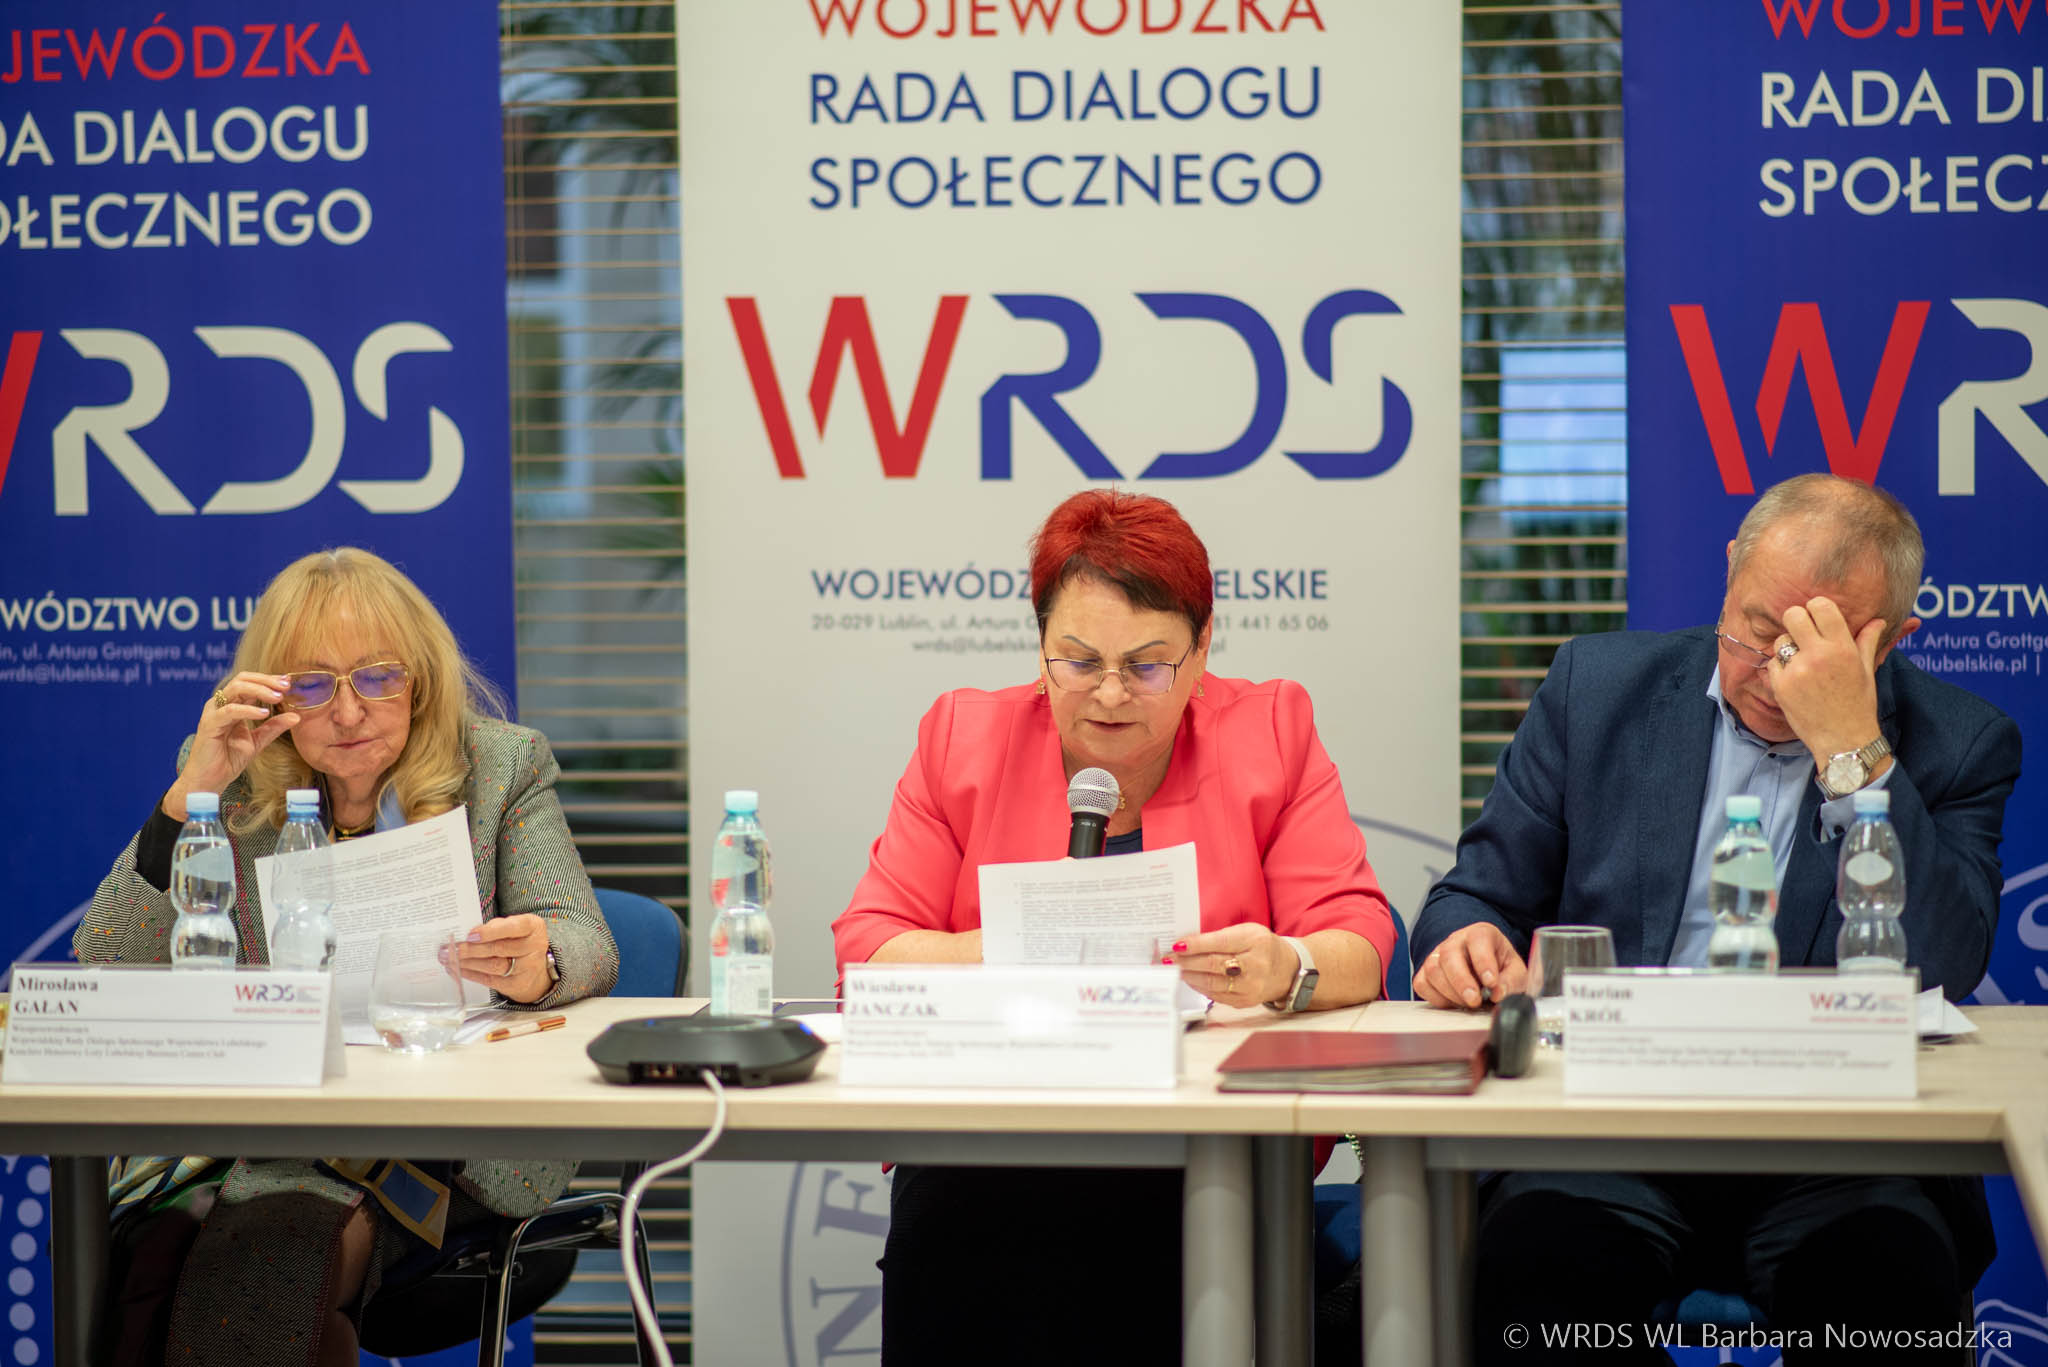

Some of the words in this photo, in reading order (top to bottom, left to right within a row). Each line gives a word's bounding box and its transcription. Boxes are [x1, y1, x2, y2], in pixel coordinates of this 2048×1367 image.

[1761, 0, 2048, 40] WOJEW
[810, 72, 986, 124] RADA
[1012, 66, 1321, 122] DIALOGU
[1761, 68, 1952, 128] RADA
[1976, 66, 2048, 124] DI
[74, 105, 369, 165] DIALOGU
[810, 152, 1323, 210] SPOŁECZNEGO
[0, 188, 373, 249] ŁECZNEGO
[725, 288, 1413, 481] WRDS
[0, 322, 465, 516] RDS
[1924, 632, 1978, 649] Artura
